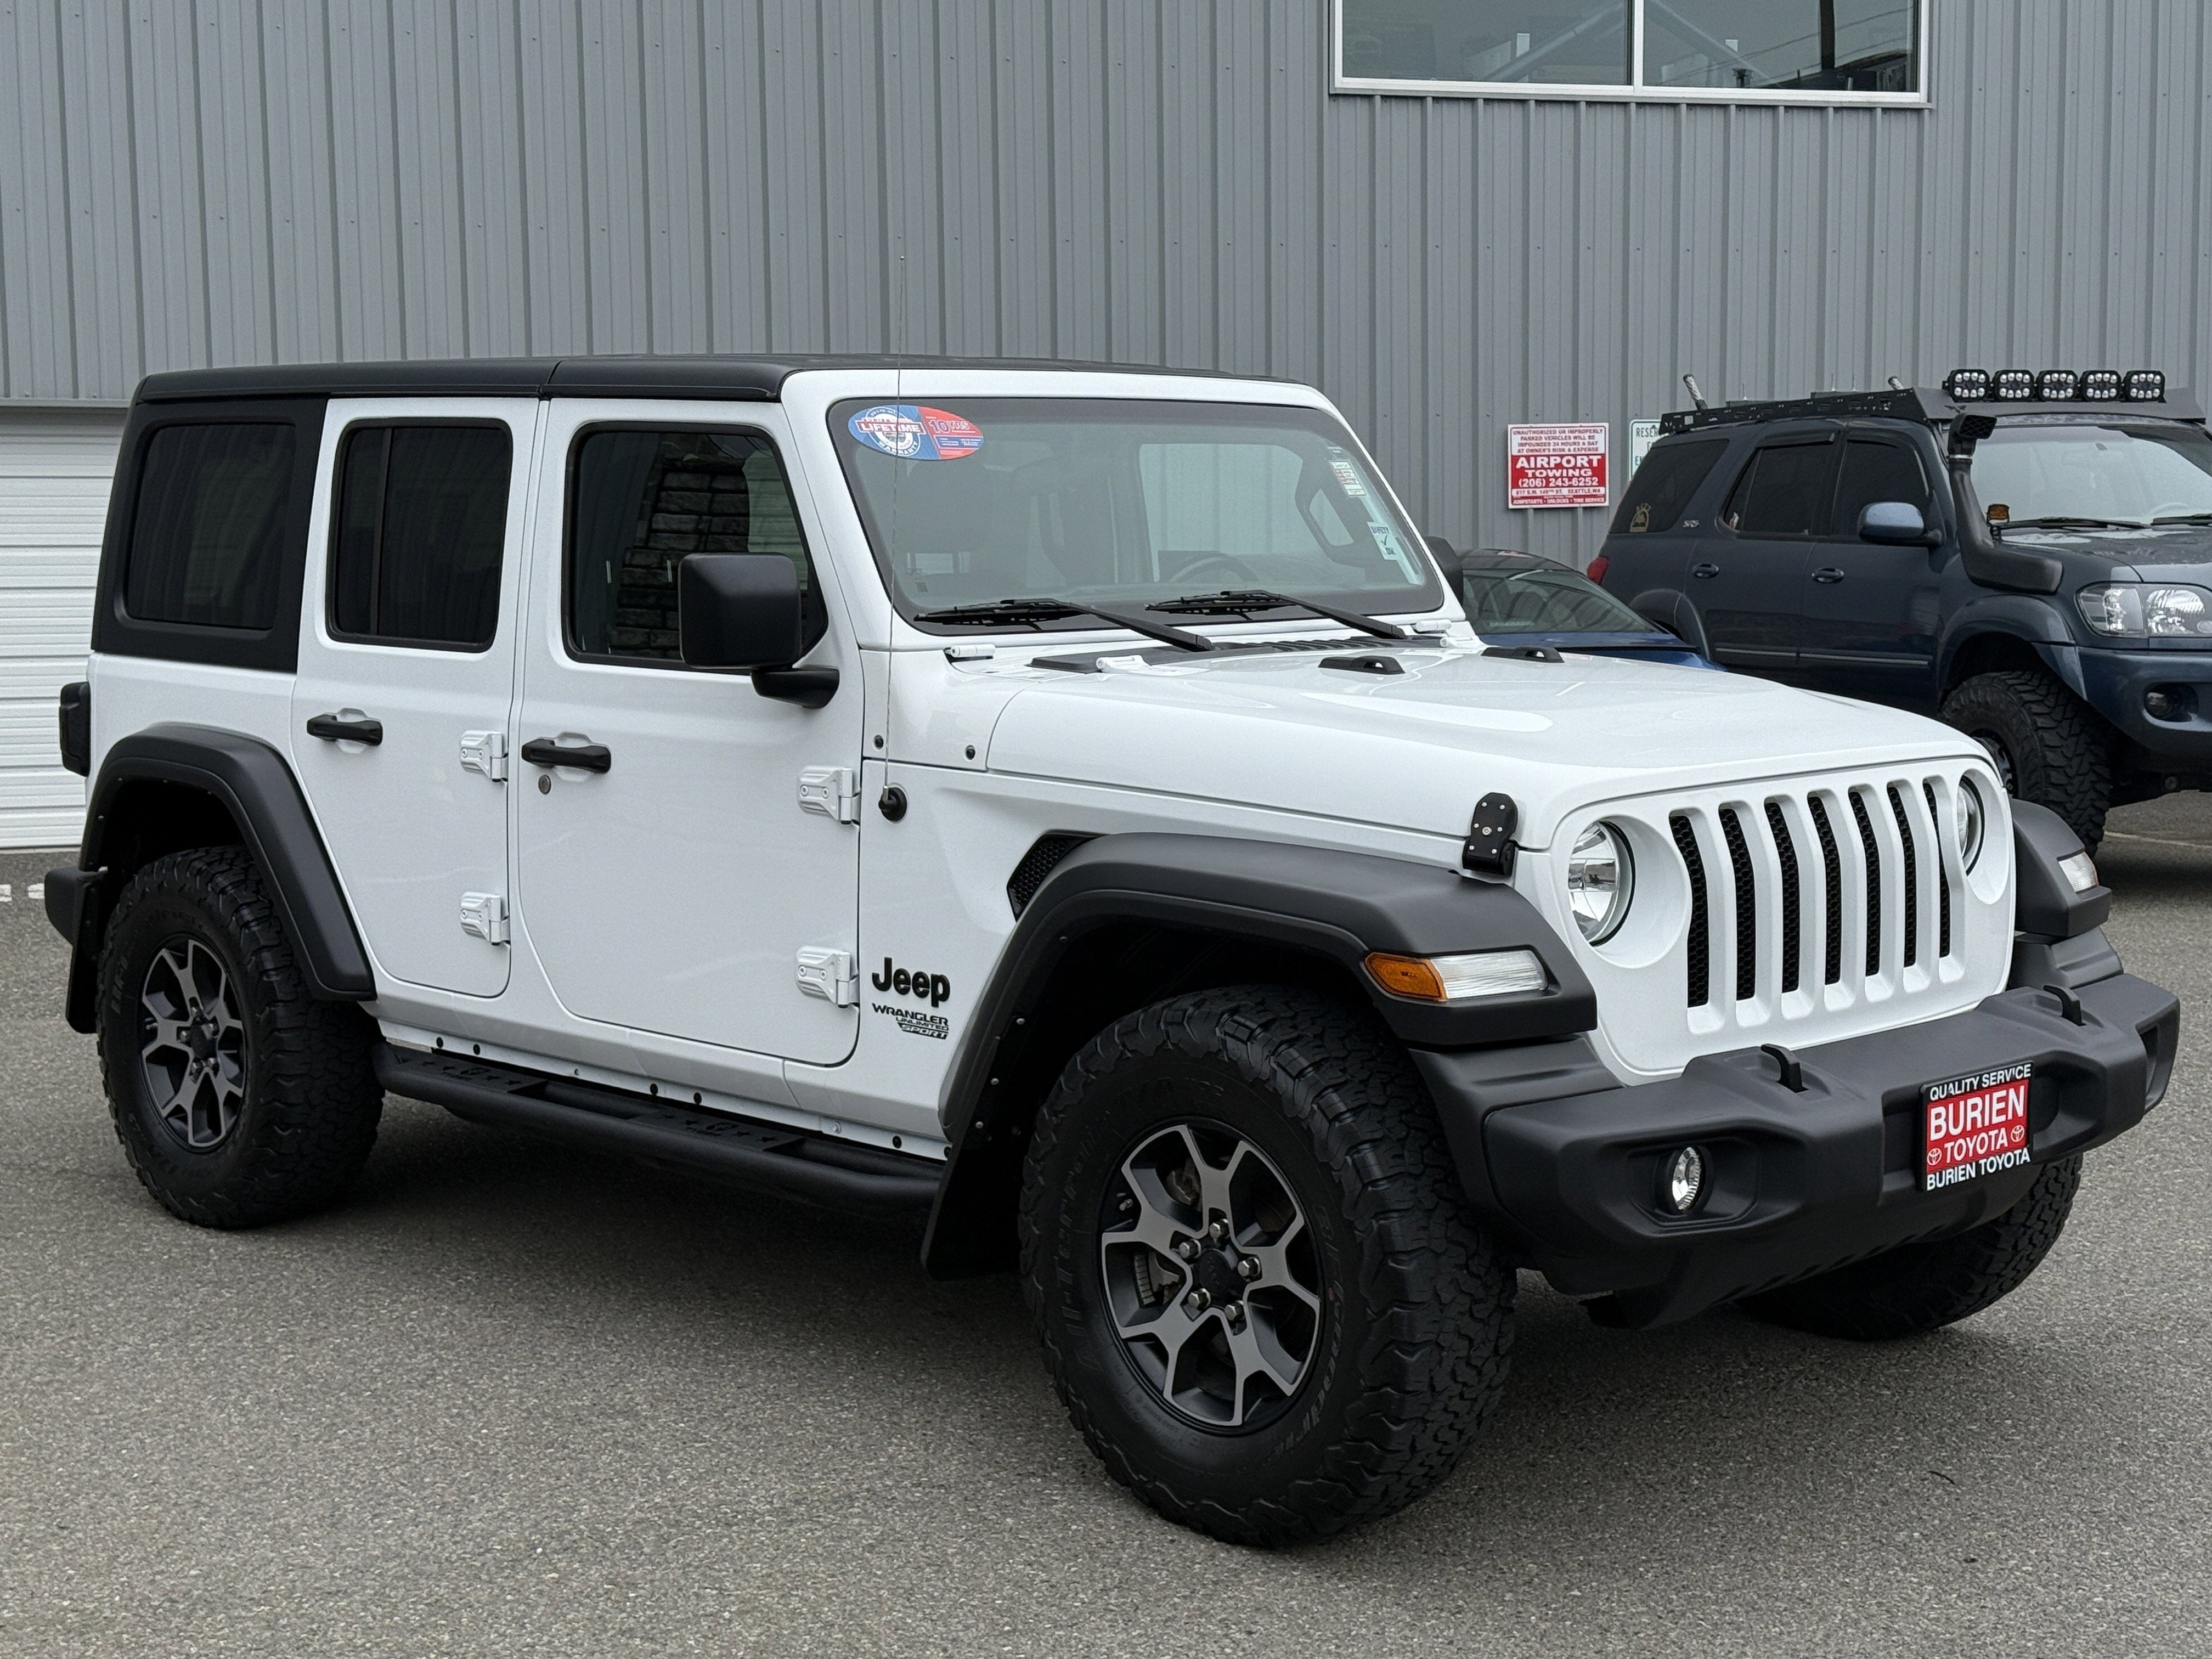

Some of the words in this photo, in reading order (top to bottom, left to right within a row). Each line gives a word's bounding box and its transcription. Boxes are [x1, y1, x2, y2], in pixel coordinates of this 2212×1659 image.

[860, 422, 922, 432] LIFETIME
[1515, 455, 1601, 469] AIRPORT
[1518, 478, 1546, 488] (206)
[1549, 477, 1599, 487] 243-6252
[1525, 469, 1593, 478] TOWING
[872, 956, 951, 1008] Jeep
[872, 1002, 950, 1026] WRANGLER
[895, 1016, 950, 1031] UNLIMITED
[900, 1024, 949, 1039] SPORT
[1930, 1076, 1980, 1101] QUALITY
[1982, 1063, 2032, 1088] SERVICE
[1930, 1085, 2025, 1141] BURIEN
[1944, 1127, 2008, 1164] TOYOTA
[1927, 1161, 1976, 1192] BURIEN
[1979, 1147, 2030, 1175] TOYOTA
